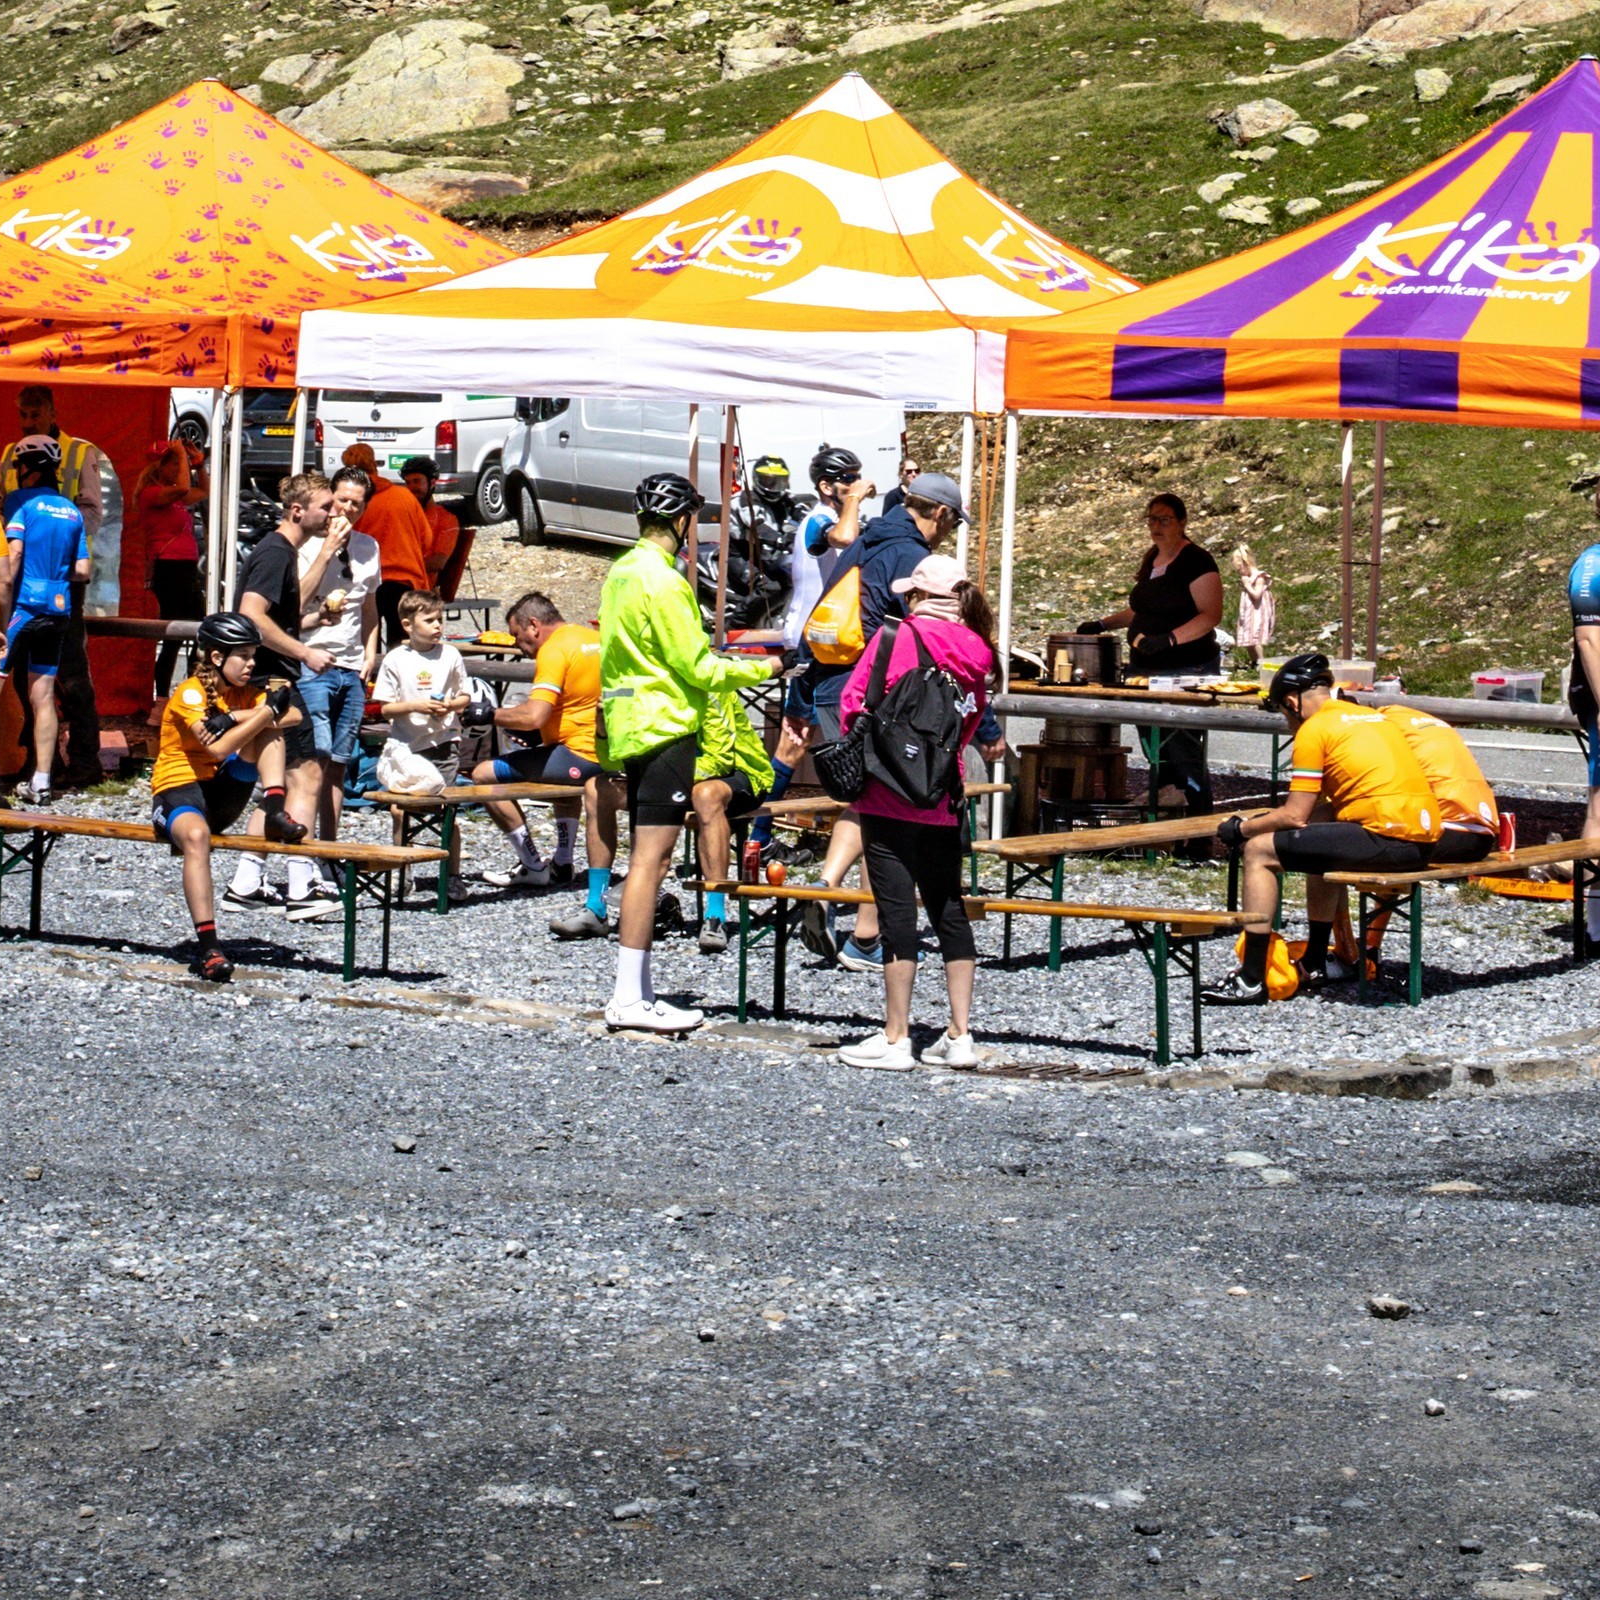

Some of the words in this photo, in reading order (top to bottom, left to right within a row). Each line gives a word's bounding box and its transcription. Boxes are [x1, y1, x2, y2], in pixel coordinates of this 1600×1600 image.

[290, 222, 435, 273] Kika
[631, 209, 802, 267] Kika
[1332, 212, 1600, 283] Kika
[639, 259, 776, 281] kinderenkankervrij
[1352, 282, 1570, 305] kinderenkankervrij
